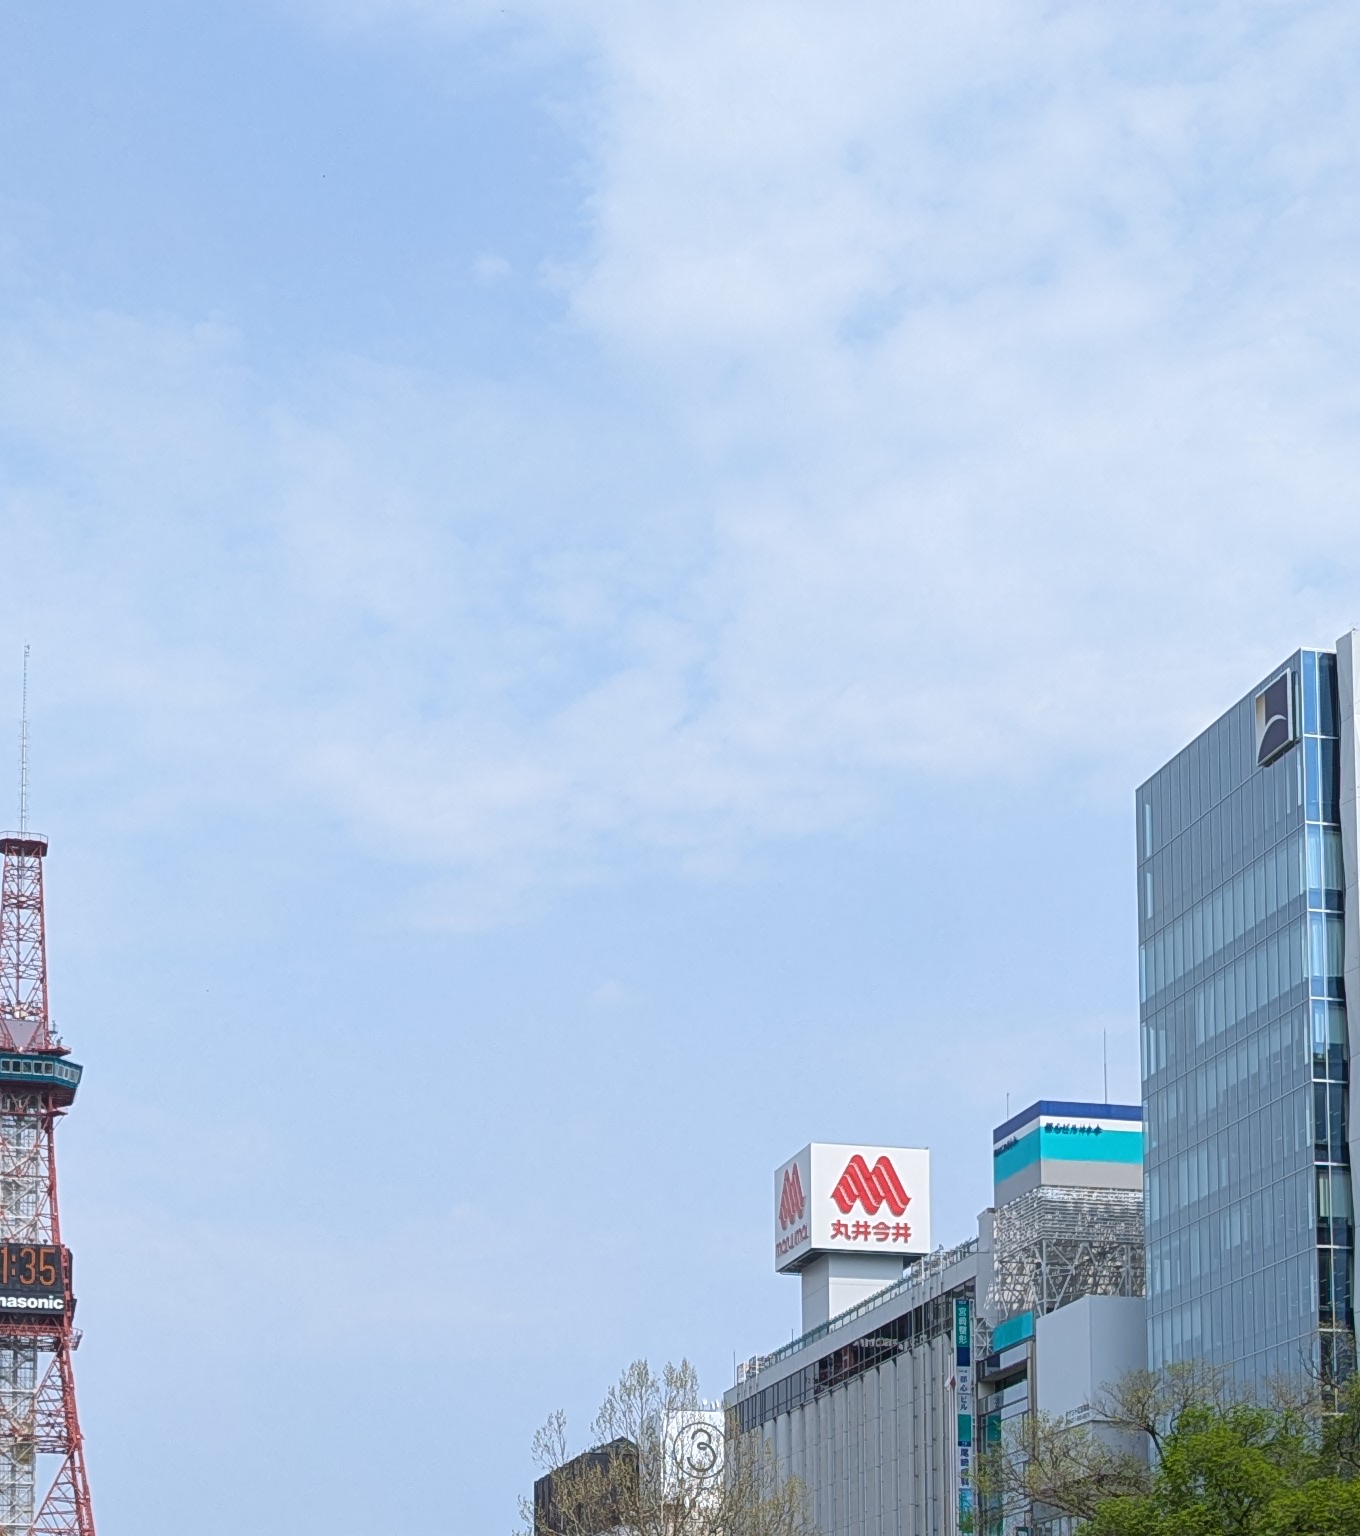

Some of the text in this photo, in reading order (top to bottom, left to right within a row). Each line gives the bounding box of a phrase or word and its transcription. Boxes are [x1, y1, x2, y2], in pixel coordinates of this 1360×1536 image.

[830, 1219, 912, 1244] 丸井今井
[1, 1247, 56, 1286] 1:35
